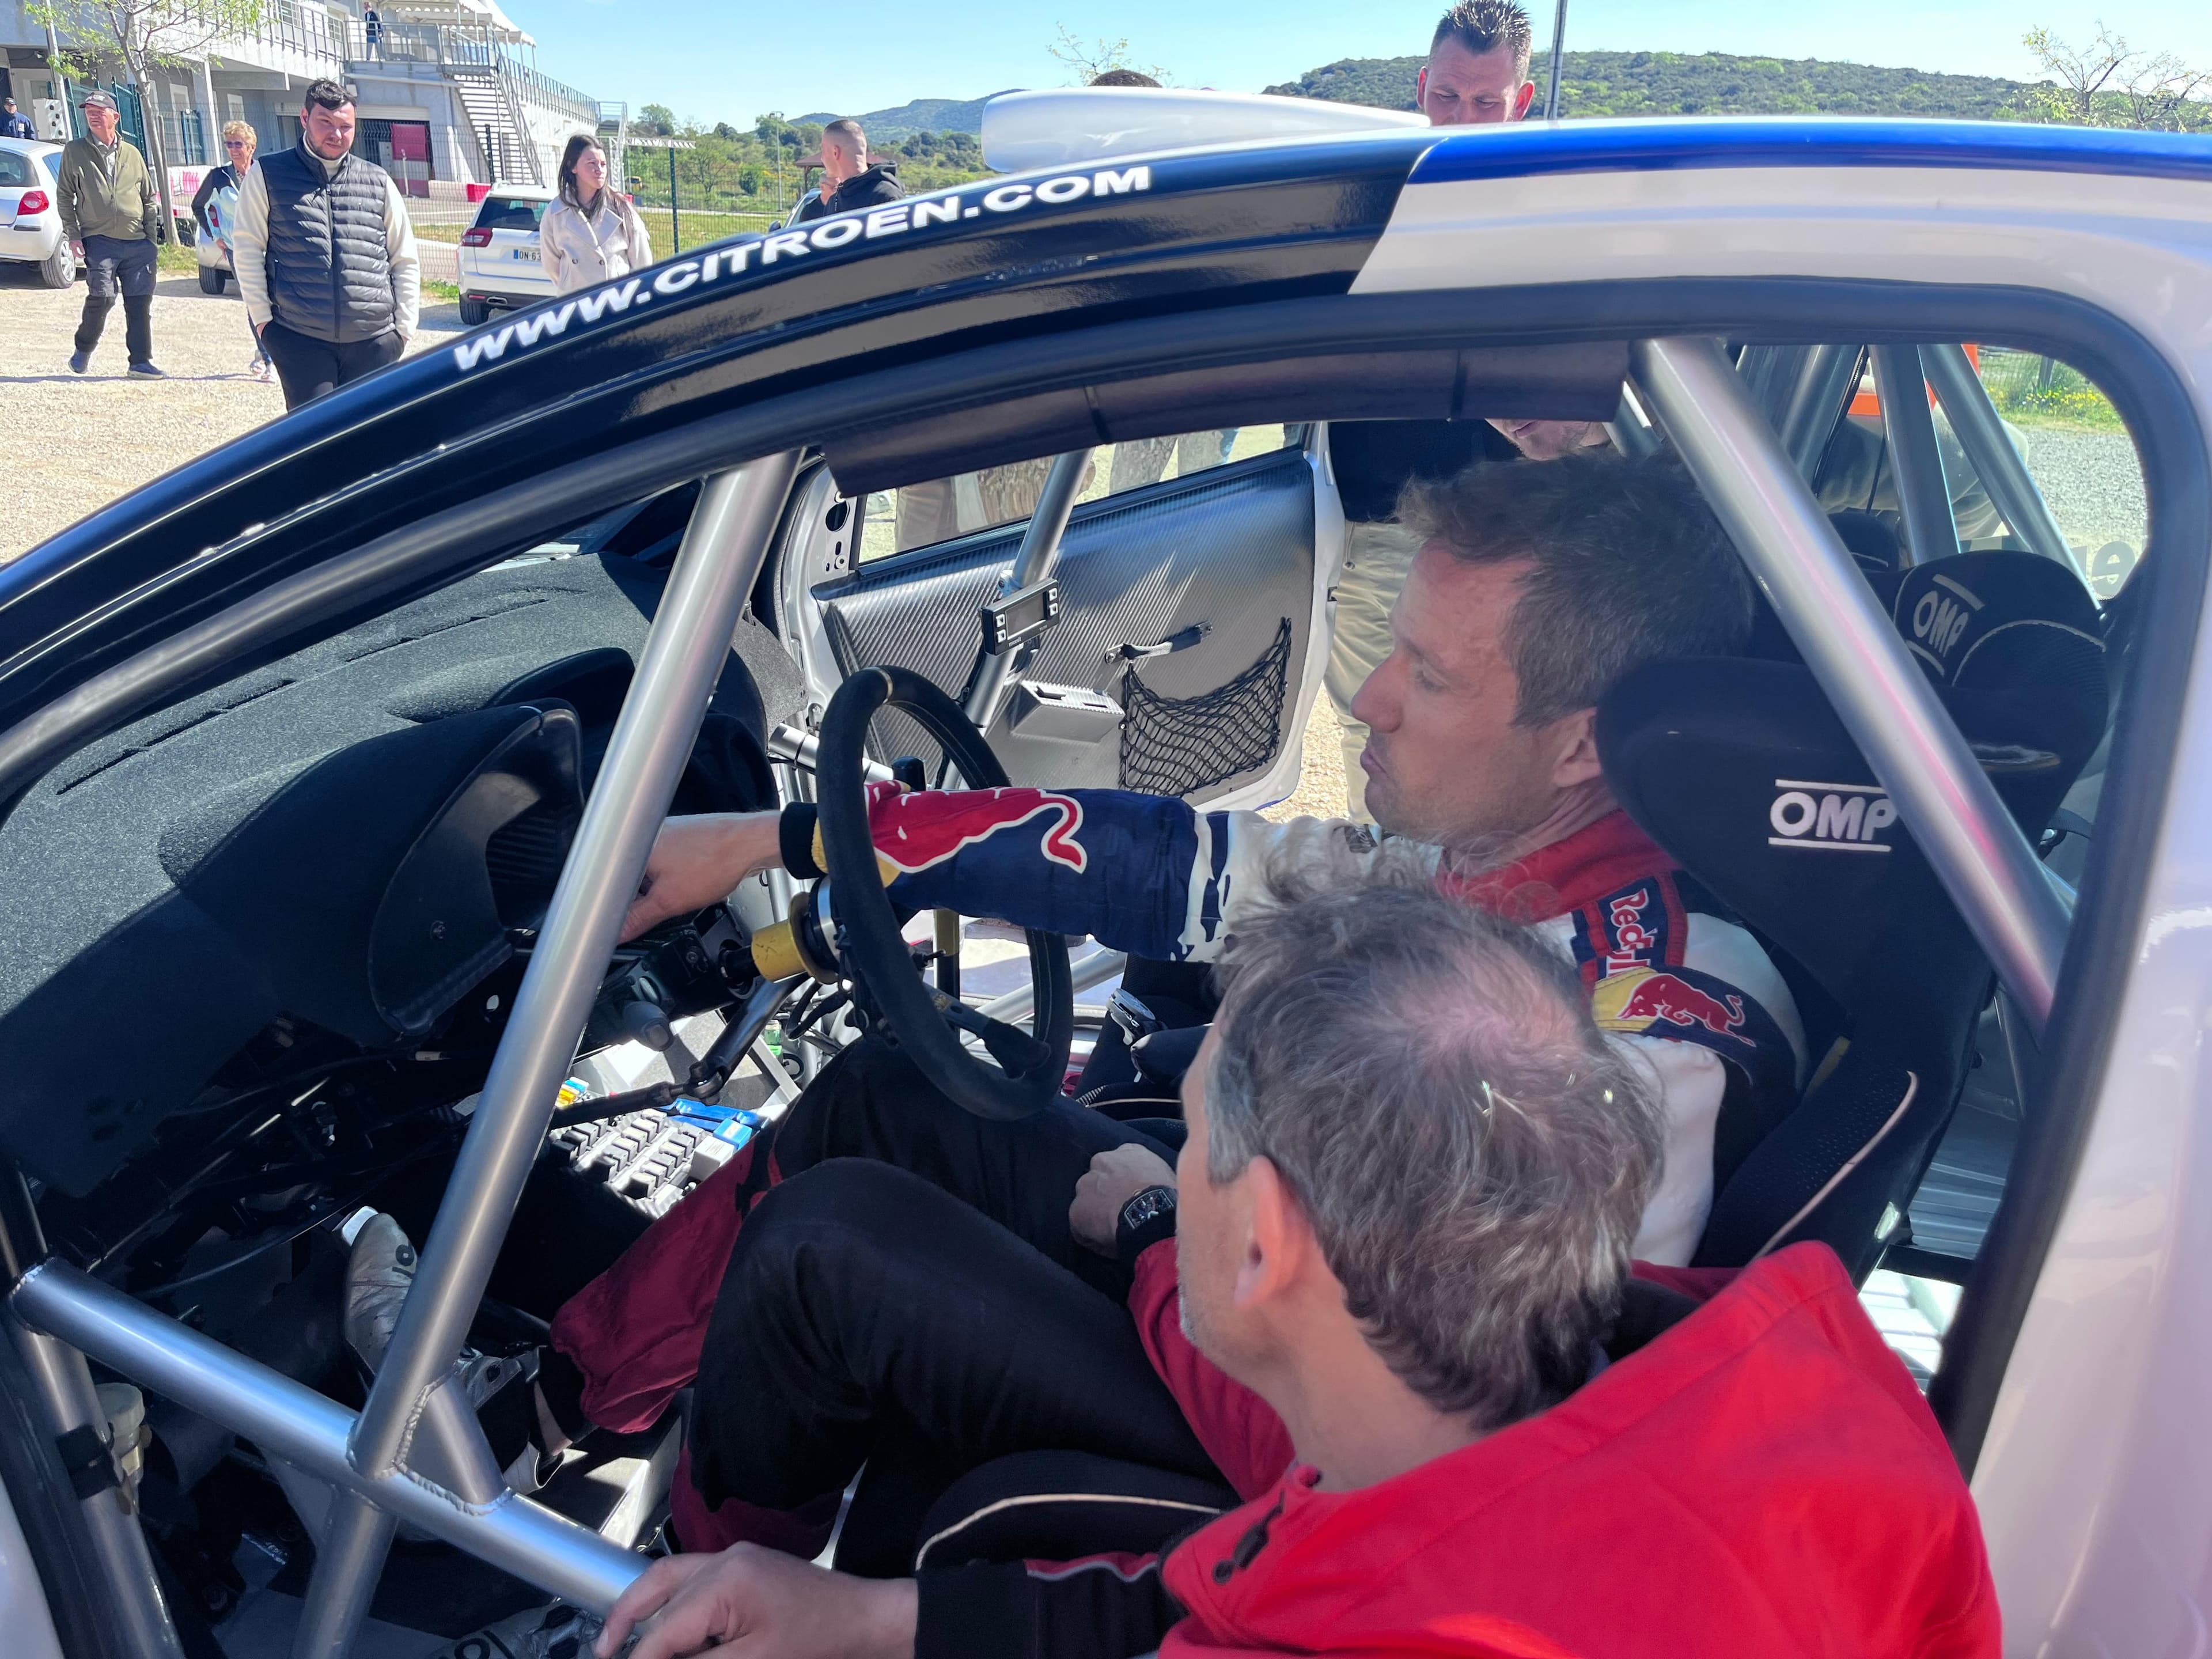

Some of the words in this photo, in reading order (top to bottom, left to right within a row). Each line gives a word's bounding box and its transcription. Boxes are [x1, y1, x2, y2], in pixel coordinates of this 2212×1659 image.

[453, 166, 1149, 370] WWW.CITROEN.COM
[1914, 590, 1968, 657] OMP
[1770, 791, 1897, 841] OMP
[1610, 888, 1658, 950] Red
